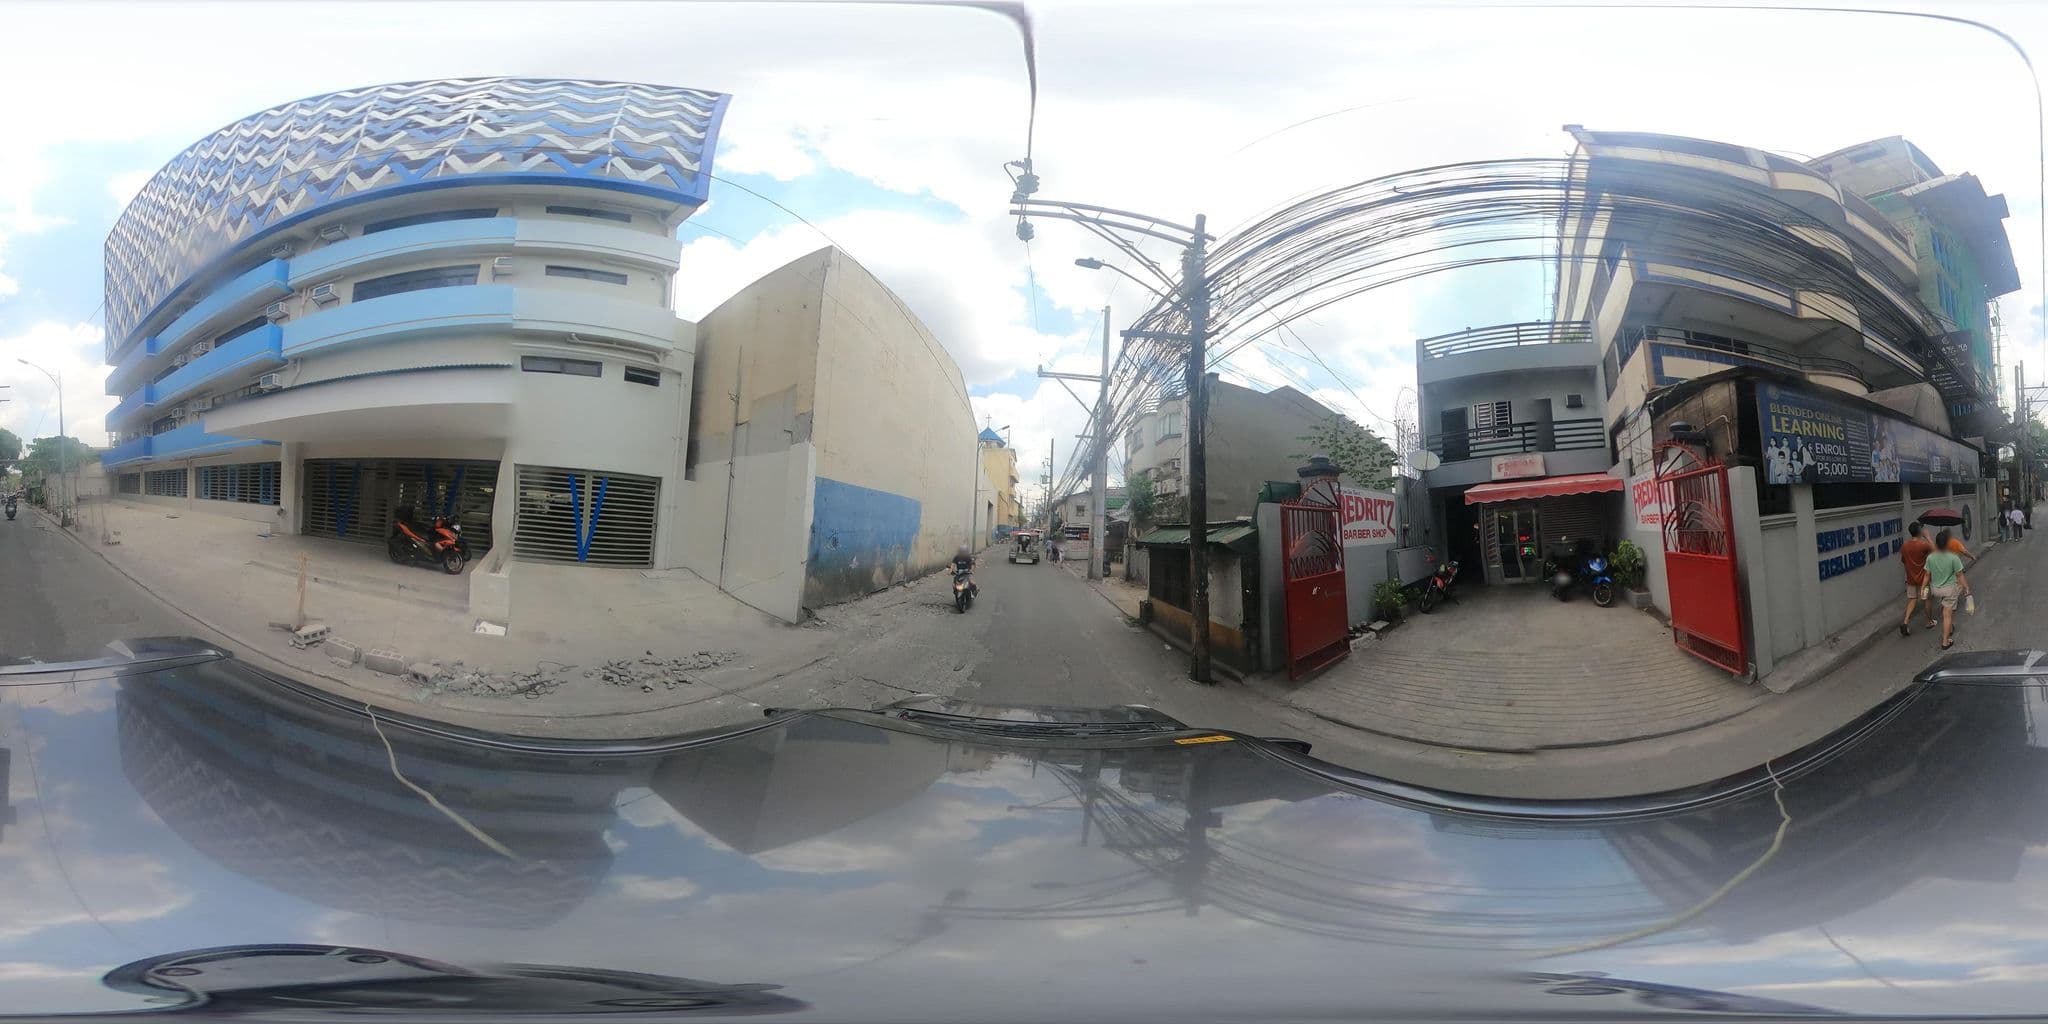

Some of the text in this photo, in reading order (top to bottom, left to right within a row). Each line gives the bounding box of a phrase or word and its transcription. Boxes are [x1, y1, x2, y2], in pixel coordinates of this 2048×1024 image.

[1770, 403, 1814, 418] BLENDED
[1772, 416, 1844, 440] LEARNING
[1815, 442, 1847, 456] ENROLL
[1817, 462, 1848, 475] P5,000
[1338, 494, 1395, 536] REDRITZ
[1343, 528, 1387, 540] BARBER SHOP
